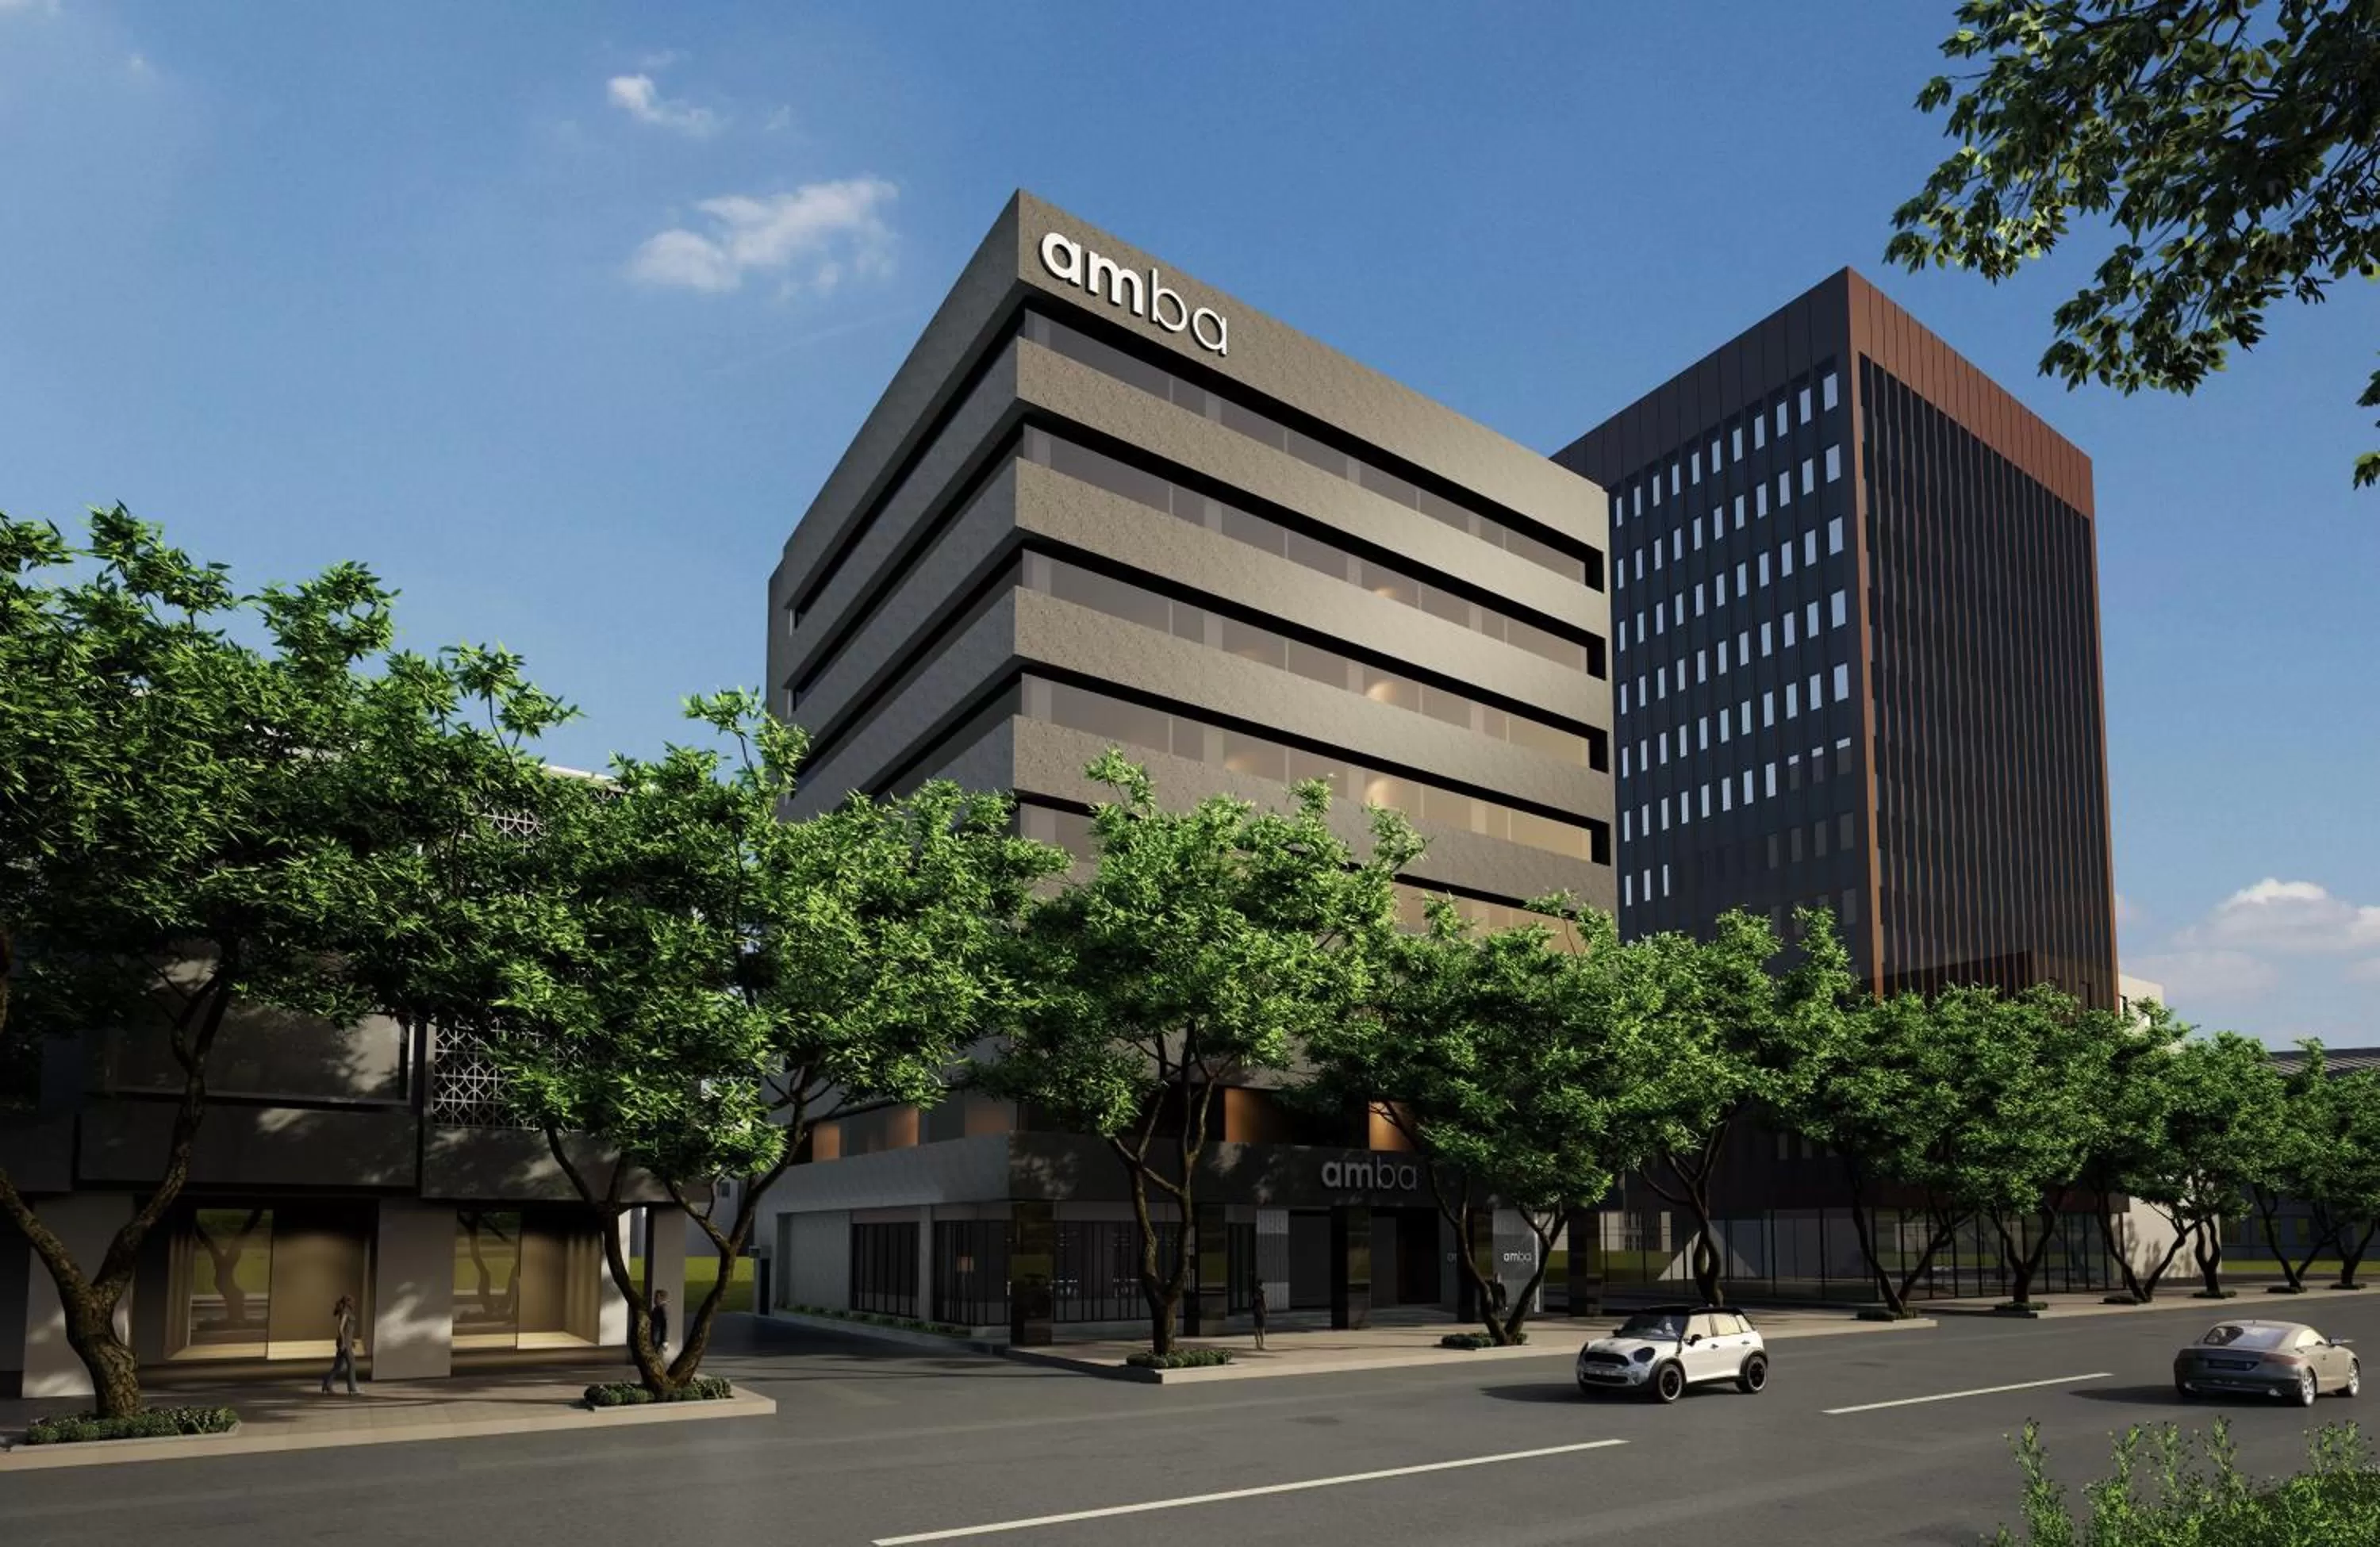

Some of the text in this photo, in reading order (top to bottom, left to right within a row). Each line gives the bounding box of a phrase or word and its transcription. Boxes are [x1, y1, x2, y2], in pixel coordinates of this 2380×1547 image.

[1041, 232, 1227, 355] amba
[1322, 1155, 1417, 1190] amba
[1503, 1251, 1532, 1263] amba
